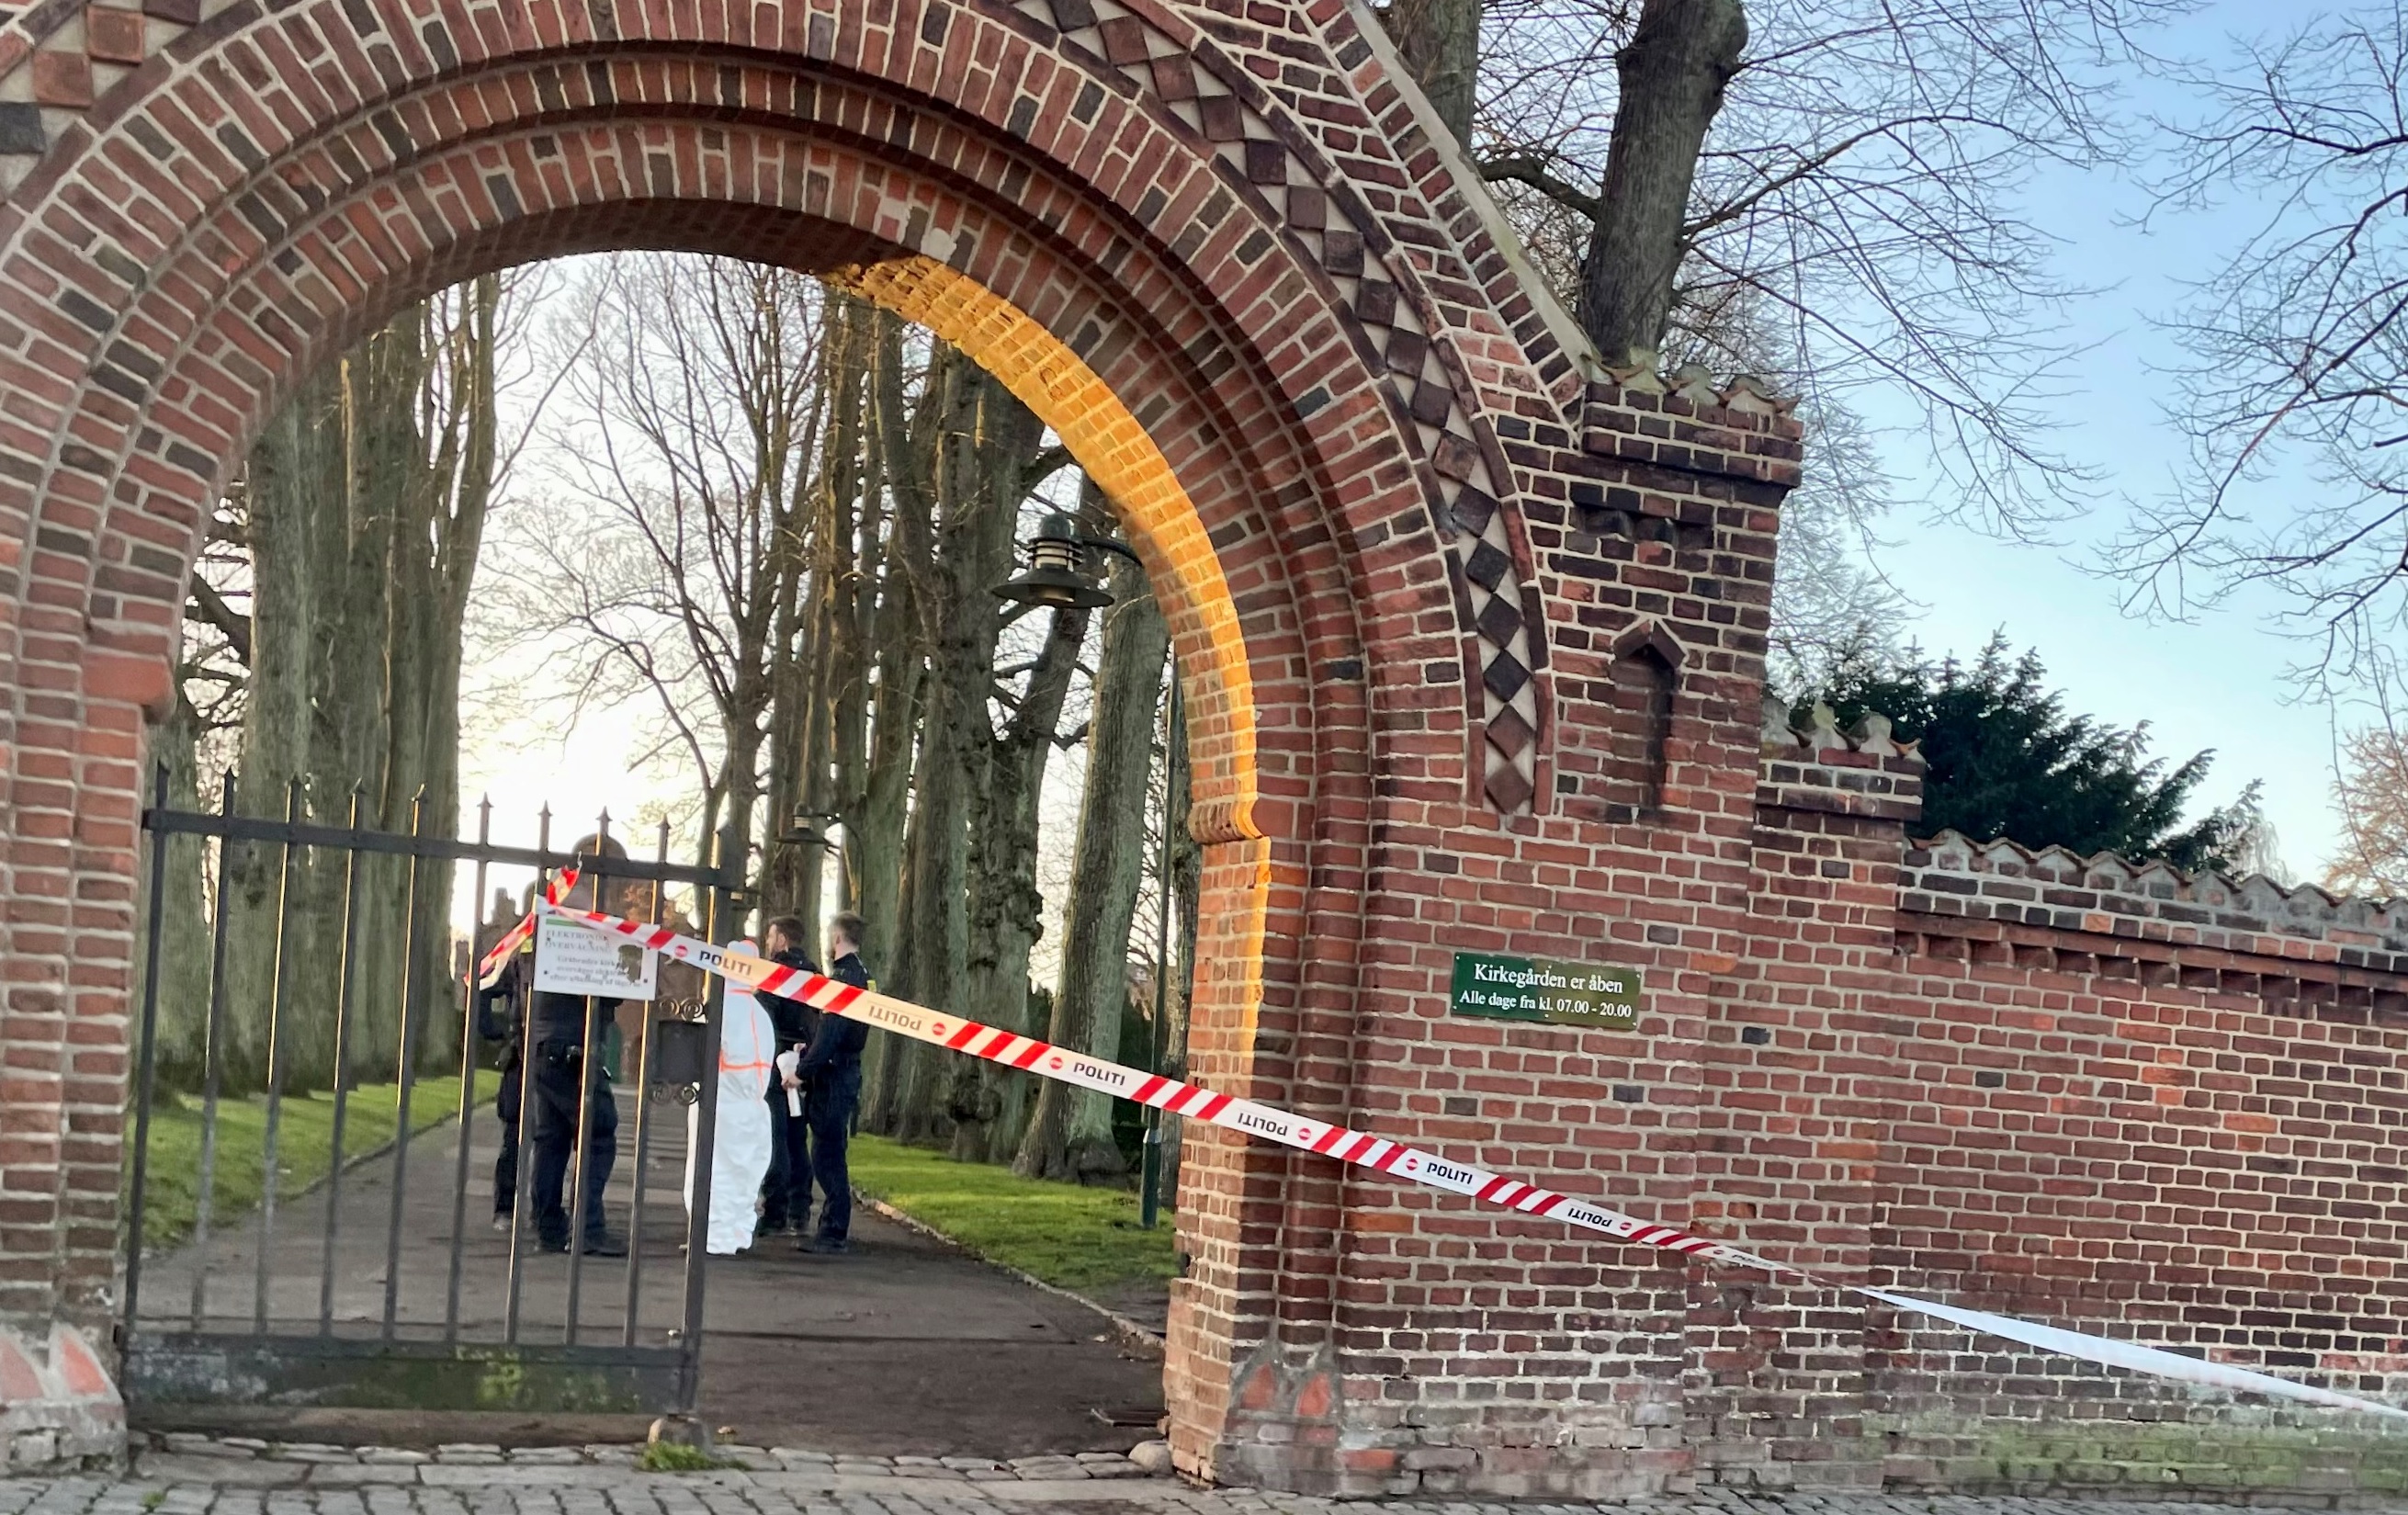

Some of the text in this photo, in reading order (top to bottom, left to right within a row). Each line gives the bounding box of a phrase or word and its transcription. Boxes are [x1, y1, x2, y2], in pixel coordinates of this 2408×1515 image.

[699, 950, 752, 976] POLITI
[1474, 963, 1623, 994] Kirkegården er åben
[1459, 990, 1486, 1005] Alle
[1488, 992, 1516, 1011] dage
[1520, 995, 1536, 1010] fra
[1538, 997, 1554, 1012] kl.
[1556, 999, 1589, 1014] 07.00
[1600, 1002, 1632, 1018] 20.00
[868, 1005, 922, 1031] POLITI
[1073, 1062, 1125, 1086] POLITI
[1238, 1113, 1288, 1136] POLITI
[1427, 1162, 1473, 1185] POLITI
[1567, 1207, 1613, 1227] POLITI
